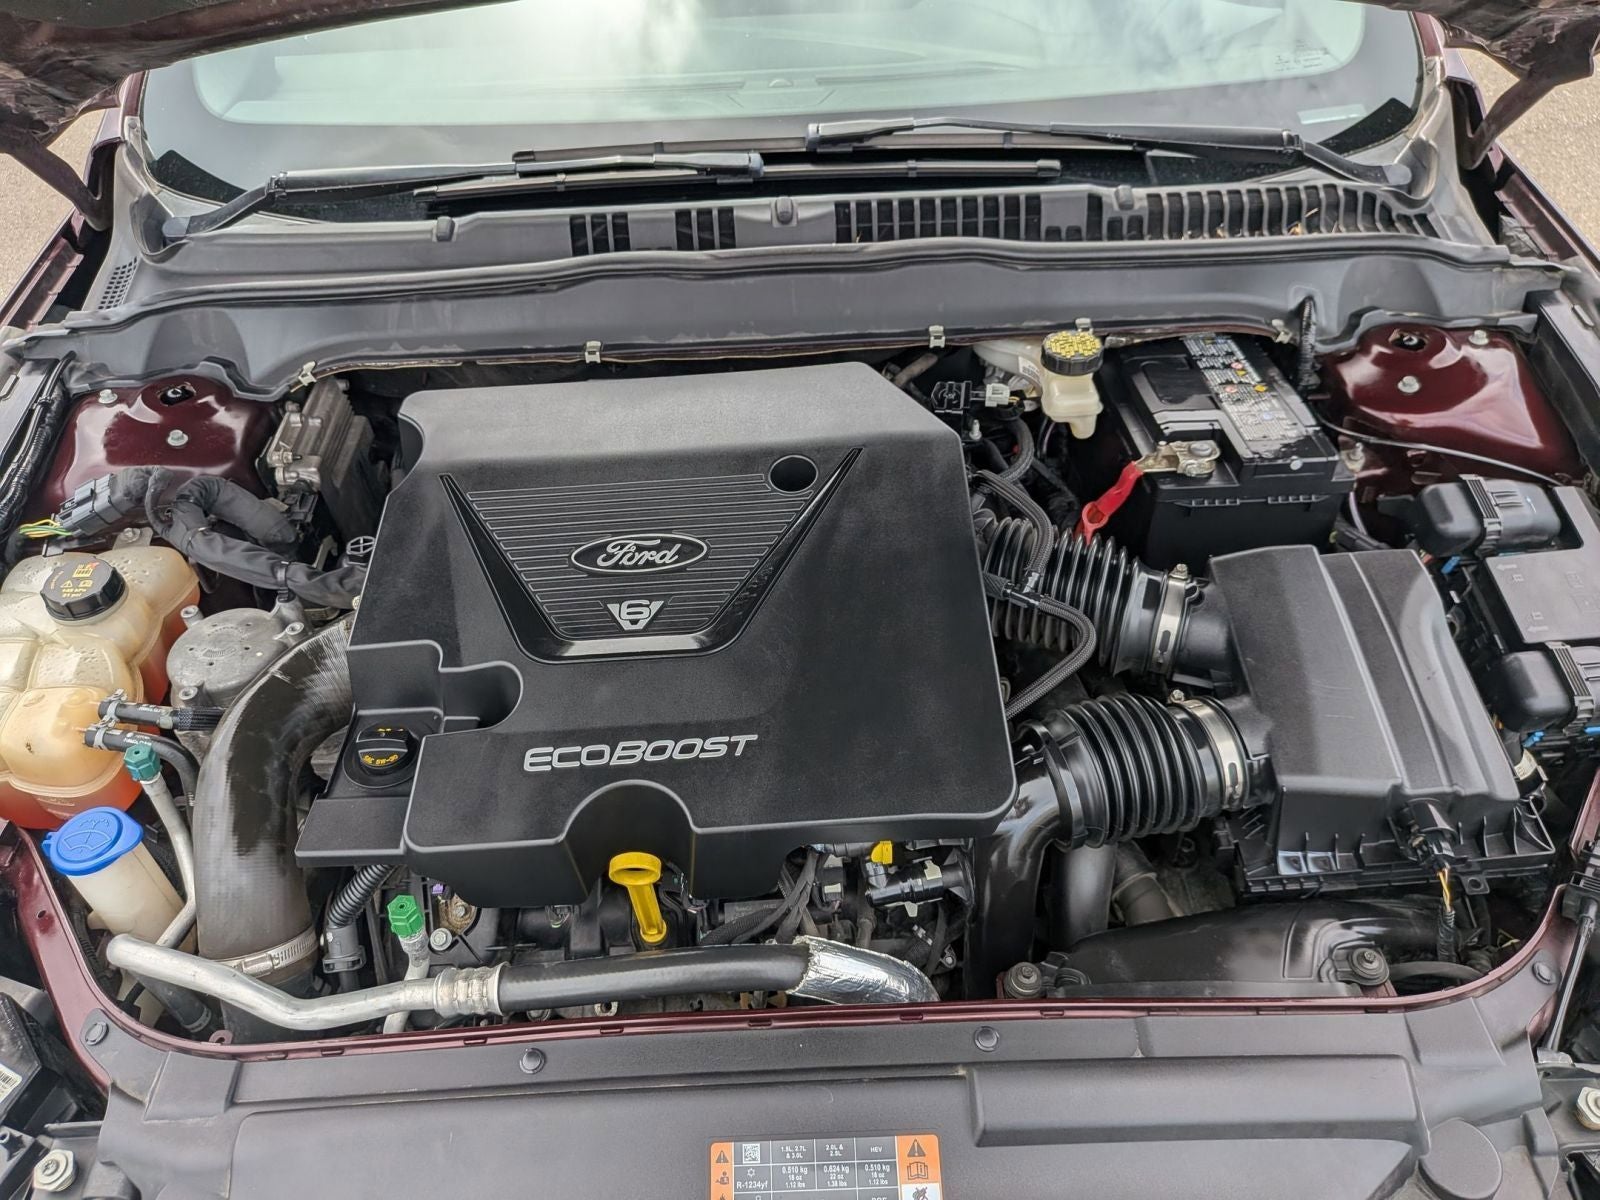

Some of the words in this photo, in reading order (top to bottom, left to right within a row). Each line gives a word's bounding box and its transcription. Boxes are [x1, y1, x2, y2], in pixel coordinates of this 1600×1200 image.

[597, 539, 681, 566] Ford
[523, 734, 758, 772] ECOBOOST
[781, 1166, 799, 1174] 0.510
[800, 1166, 808, 1175] kg
[823, 1165, 840, 1173] 0.624
[841, 1164, 850, 1174] kg
[864, 1163, 881, 1172] 0.510
[882, 1163, 890, 1172] kg
[736, 1180, 768, 1190] R-1234yf
